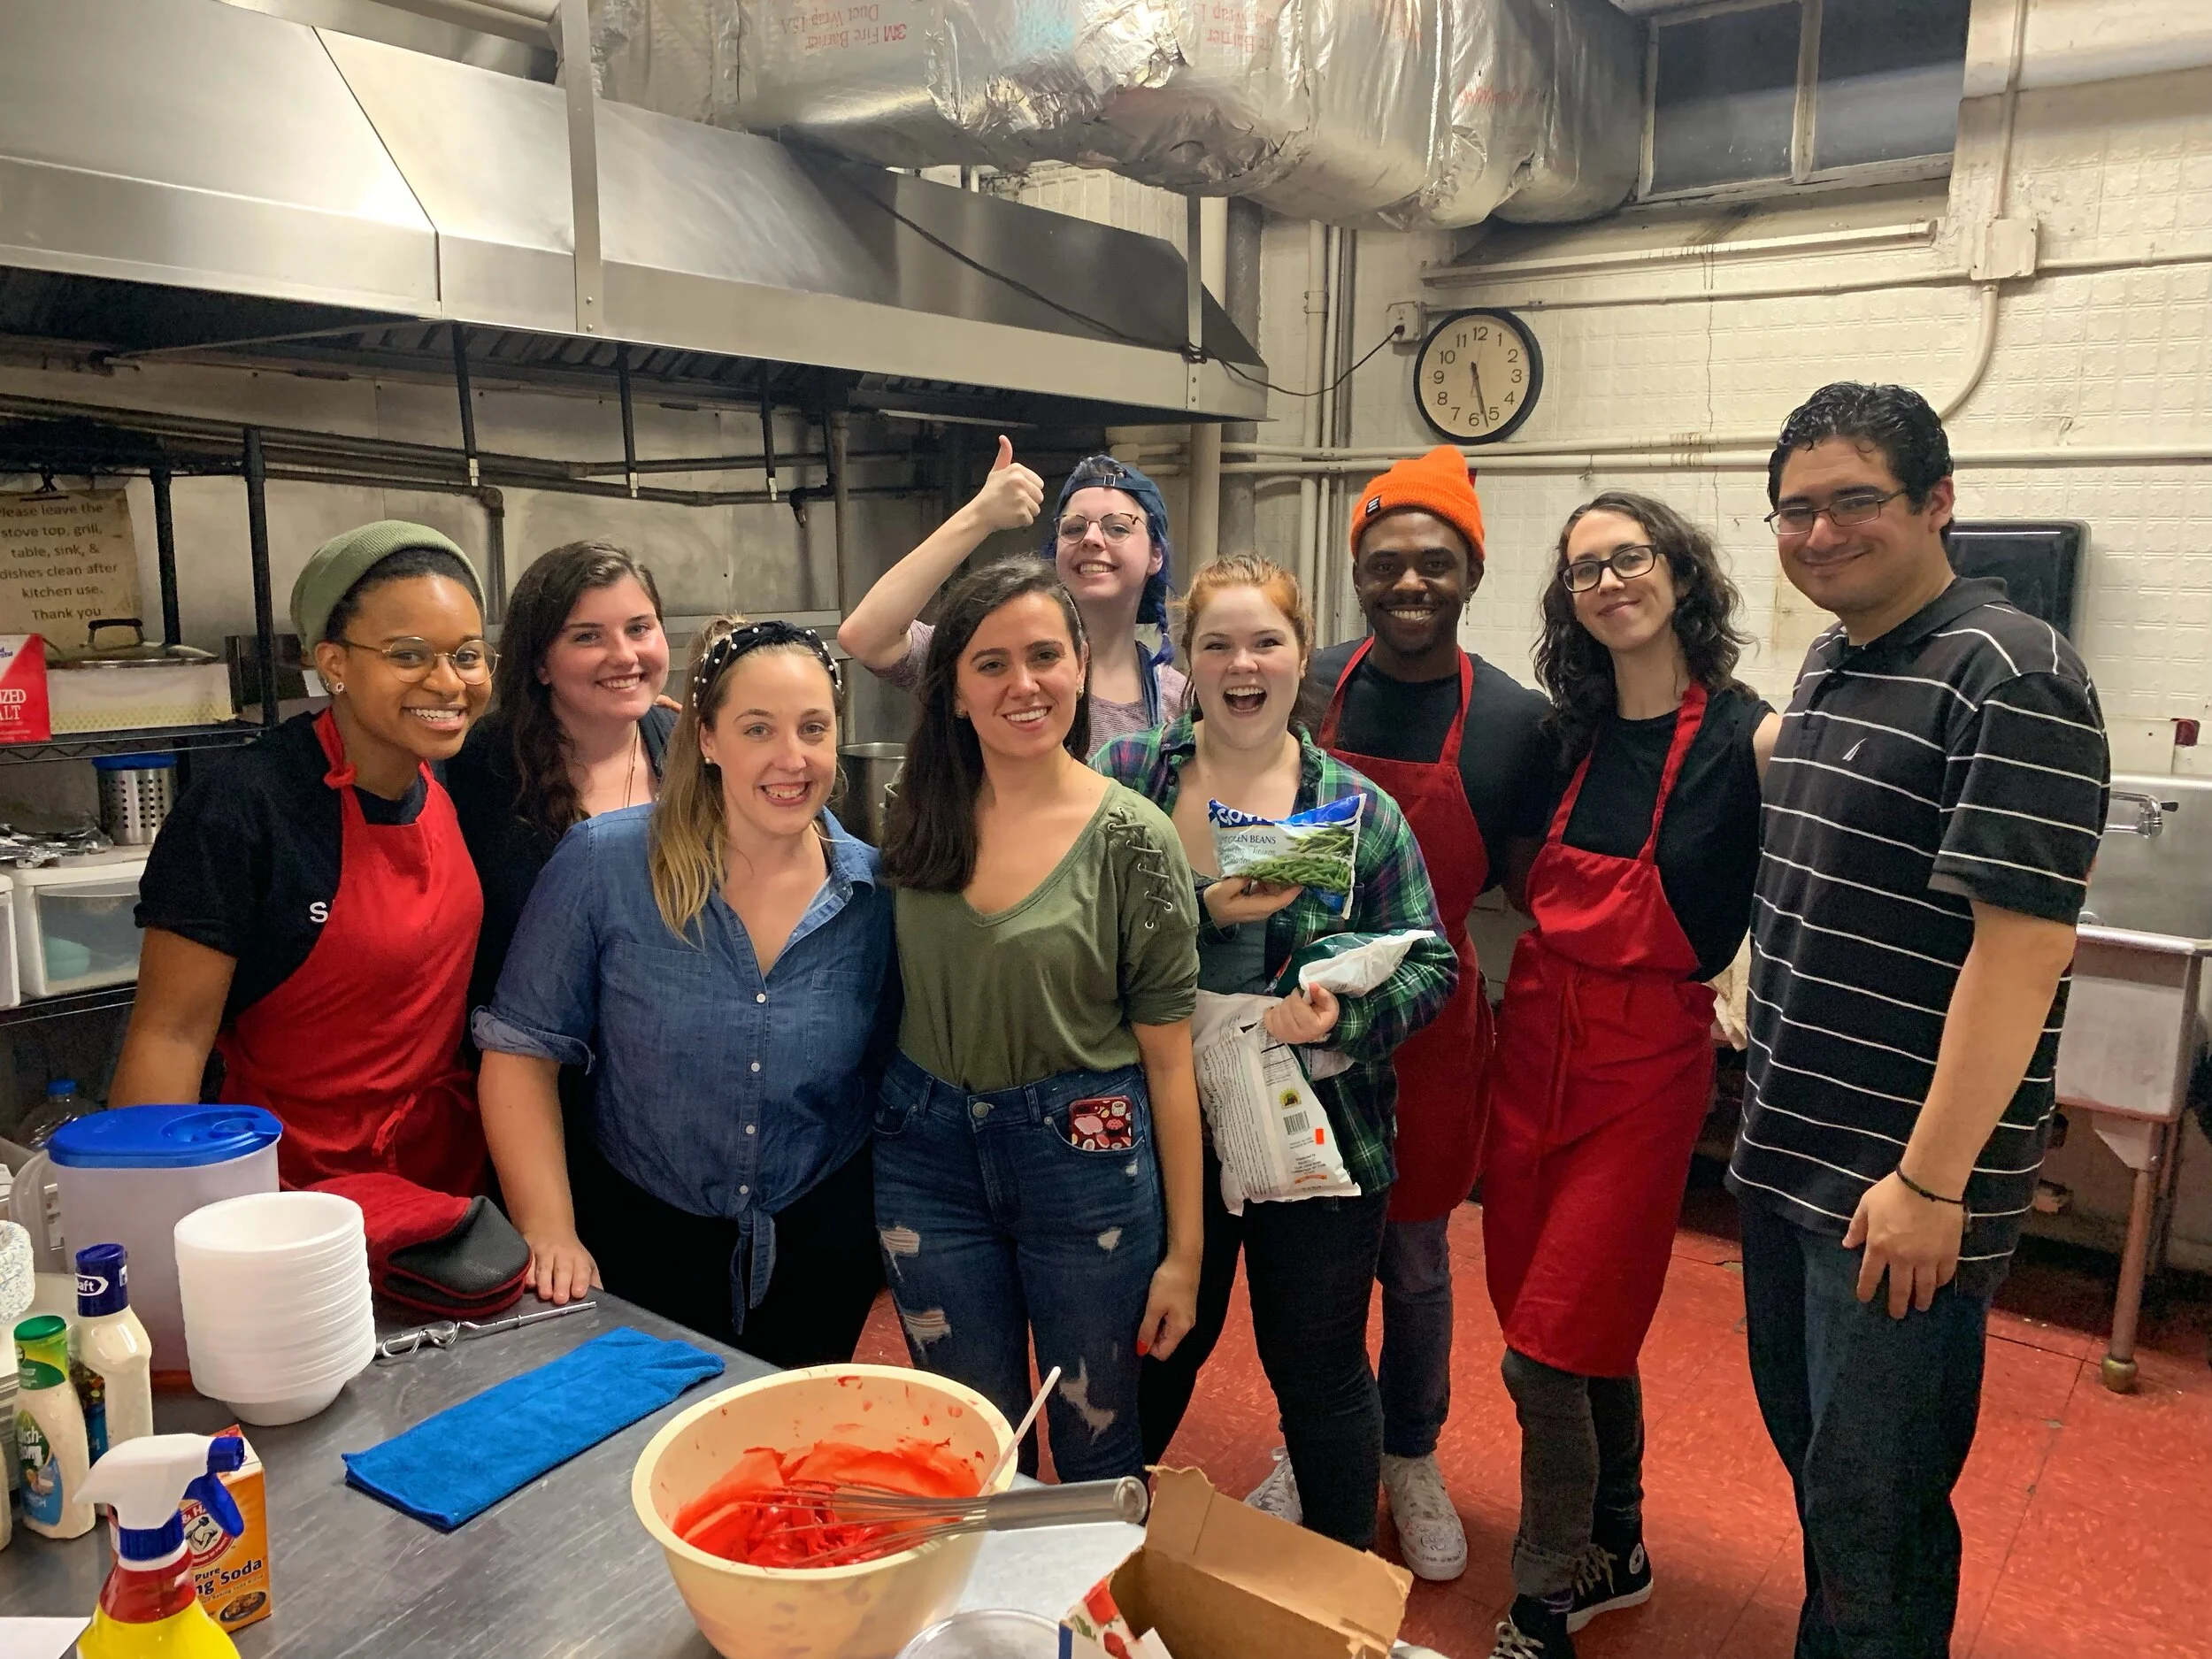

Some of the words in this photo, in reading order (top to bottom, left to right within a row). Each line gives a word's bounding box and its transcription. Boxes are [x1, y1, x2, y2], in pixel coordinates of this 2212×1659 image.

[811, 8, 843, 27] Wrap
[849, 4, 879, 21] Duct
[855, 27, 879, 45] Fire
[883, 23, 907, 42] 3M
[805, 30, 849, 50] Barrier
[1473, 326, 1488, 341] 12
[1498, 333, 1502, 347] 1
[1456, 334, 1467, 348] 11
[1440, 349, 1455, 365] 10
[1508, 349, 1518, 364] 2
[1433, 370, 1444, 384] 9
[1511, 369, 1522, 383] 3
[1437, 392, 1448, 405] 8
[1504, 391, 1515, 405] 4
[1451, 407, 1461, 421] 7
[1469, 412, 1480, 426] 6
[1489, 407, 1500, 421] 5
[0, 504, 37, 518] lease
[42, 504, 77, 515] leave
[81, 503, 104, 513] the
[2, 528, 39, 538] stove
[42, 526, 70, 538] top,
[73, 523, 103, 537] grill,
[12, 547, 50, 558] table,
[54, 544, 85, 557] sink,
[89, 543, 100, 554] &
[0, 568, 42, 580] dishes
[46, 565, 82, 577] clean
[87, 563, 118, 574] after
[21, 586, 72, 598] kitchen
[76, 585, 104, 595] use.
[31, 607, 73, 620] Thank
[77, 608, 101, 619] you
[1250, 835, 1277, 844] BEANS
[78, 1279, 95, 1292] aft
[195, 1568, 220, 1582] Pure
[220, 1560, 263, 1585] Soda
